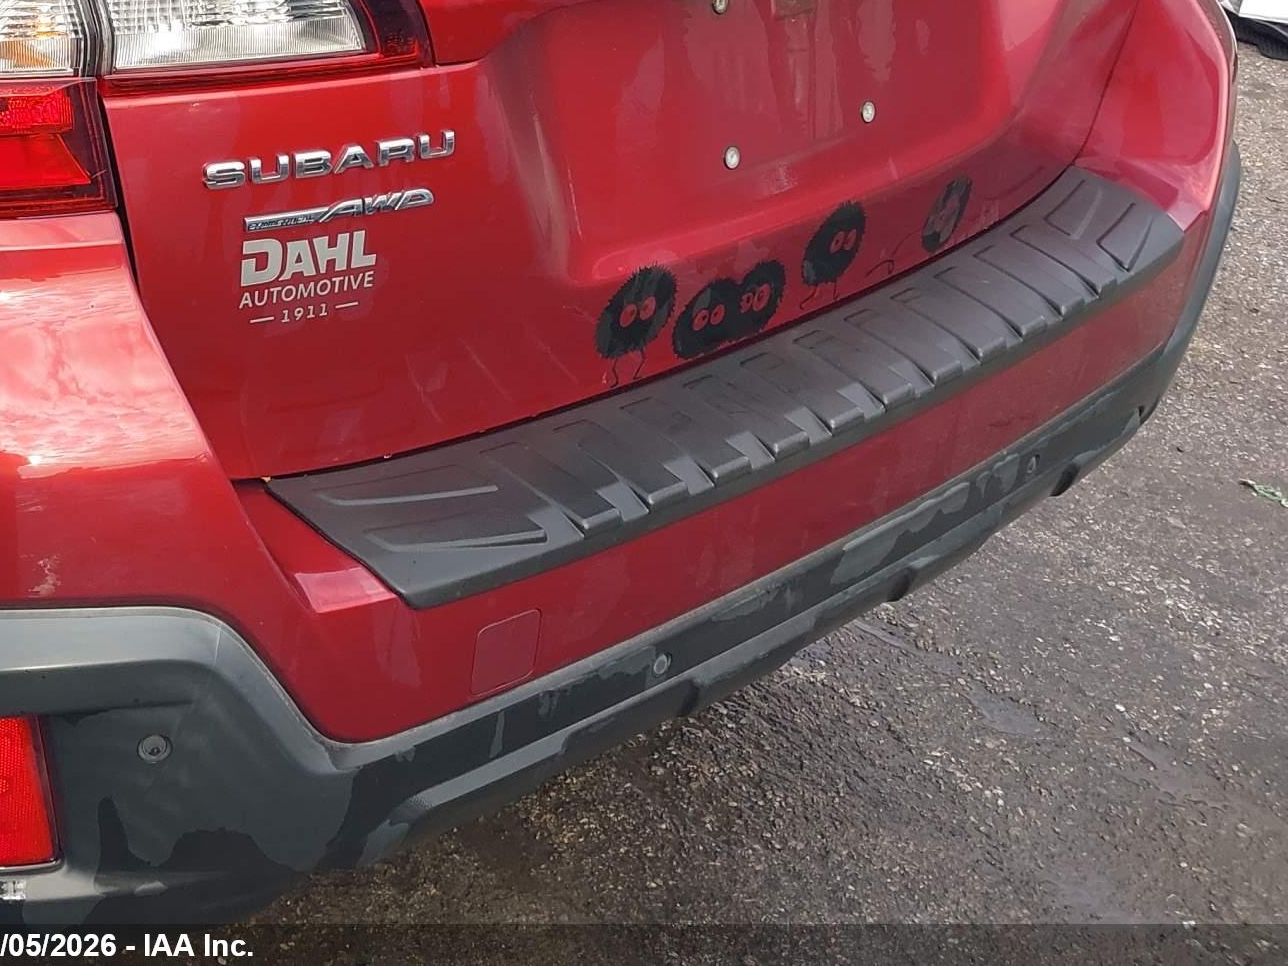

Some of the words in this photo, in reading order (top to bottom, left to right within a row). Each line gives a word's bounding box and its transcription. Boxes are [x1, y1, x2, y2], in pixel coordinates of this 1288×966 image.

[202, 129, 456, 190] SUBARU
[319, 188, 435, 222] AWD
[240, 230, 377, 287] DAHL
[239, 271, 375, 309] AUTOMOTIVE
[281, 303, 329, 323] 1911
